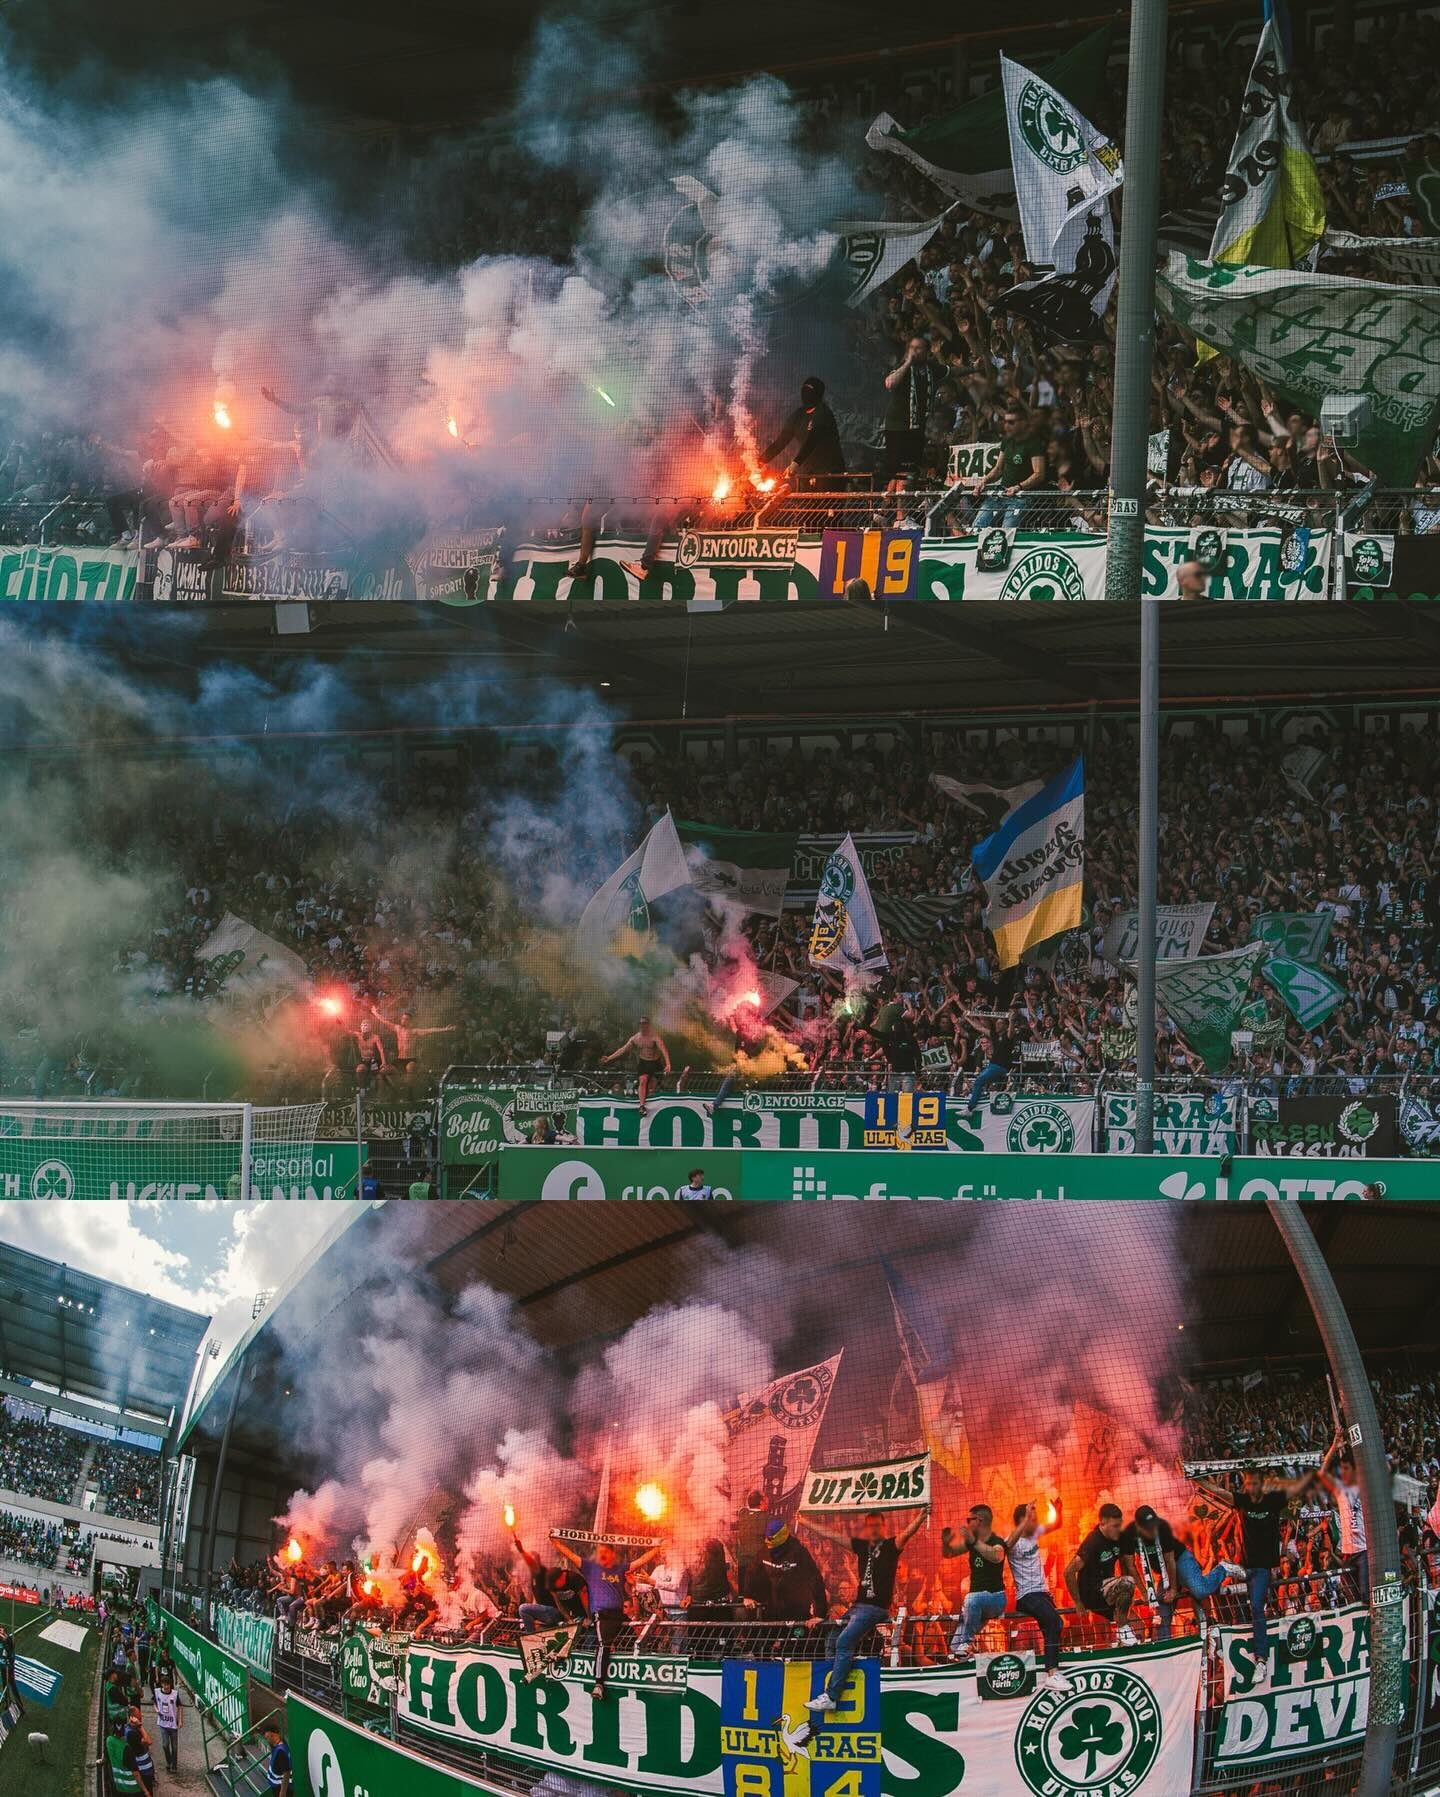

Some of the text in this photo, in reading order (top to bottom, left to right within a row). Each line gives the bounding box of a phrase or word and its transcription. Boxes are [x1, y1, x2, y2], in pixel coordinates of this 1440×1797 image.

[702, 538, 796, 559] ENTOURAGE
[881, 539, 911, 594] 9
[764, 1095, 845, 1109] ENTOURAGE
[876, 1097, 938, 1127] 1 9
[1108, 1098, 1210, 1128] SRA
[446, 1111, 490, 1138] Bella
[1012, 1105, 1053, 1131] HORIDOS
[460, 1134, 497, 1156] Ciao
[867, 1131, 944, 1145] ULT RAS
[1251, 1121, 1335, 1143] GREEN
[808, 1464, 925, 1505] ULT RAS
[558, 1528, 653, 1546] HORIDOS 1000
[343, 1647, 363, 1669] Bella
[573, 1658, 688, 1684] ENOURAGE
[349, 1667, 367, 1688] Ciao
[742, 1670, 759, 1722] 1
[1026, 1673, 1154, 1731] HORDOS 1000
[404, 1653, 965, 1797] HORIDS
[1217, 1676, 1371, 1757] DEVI
[724, 1733, 877, 1759] ULT RAS
